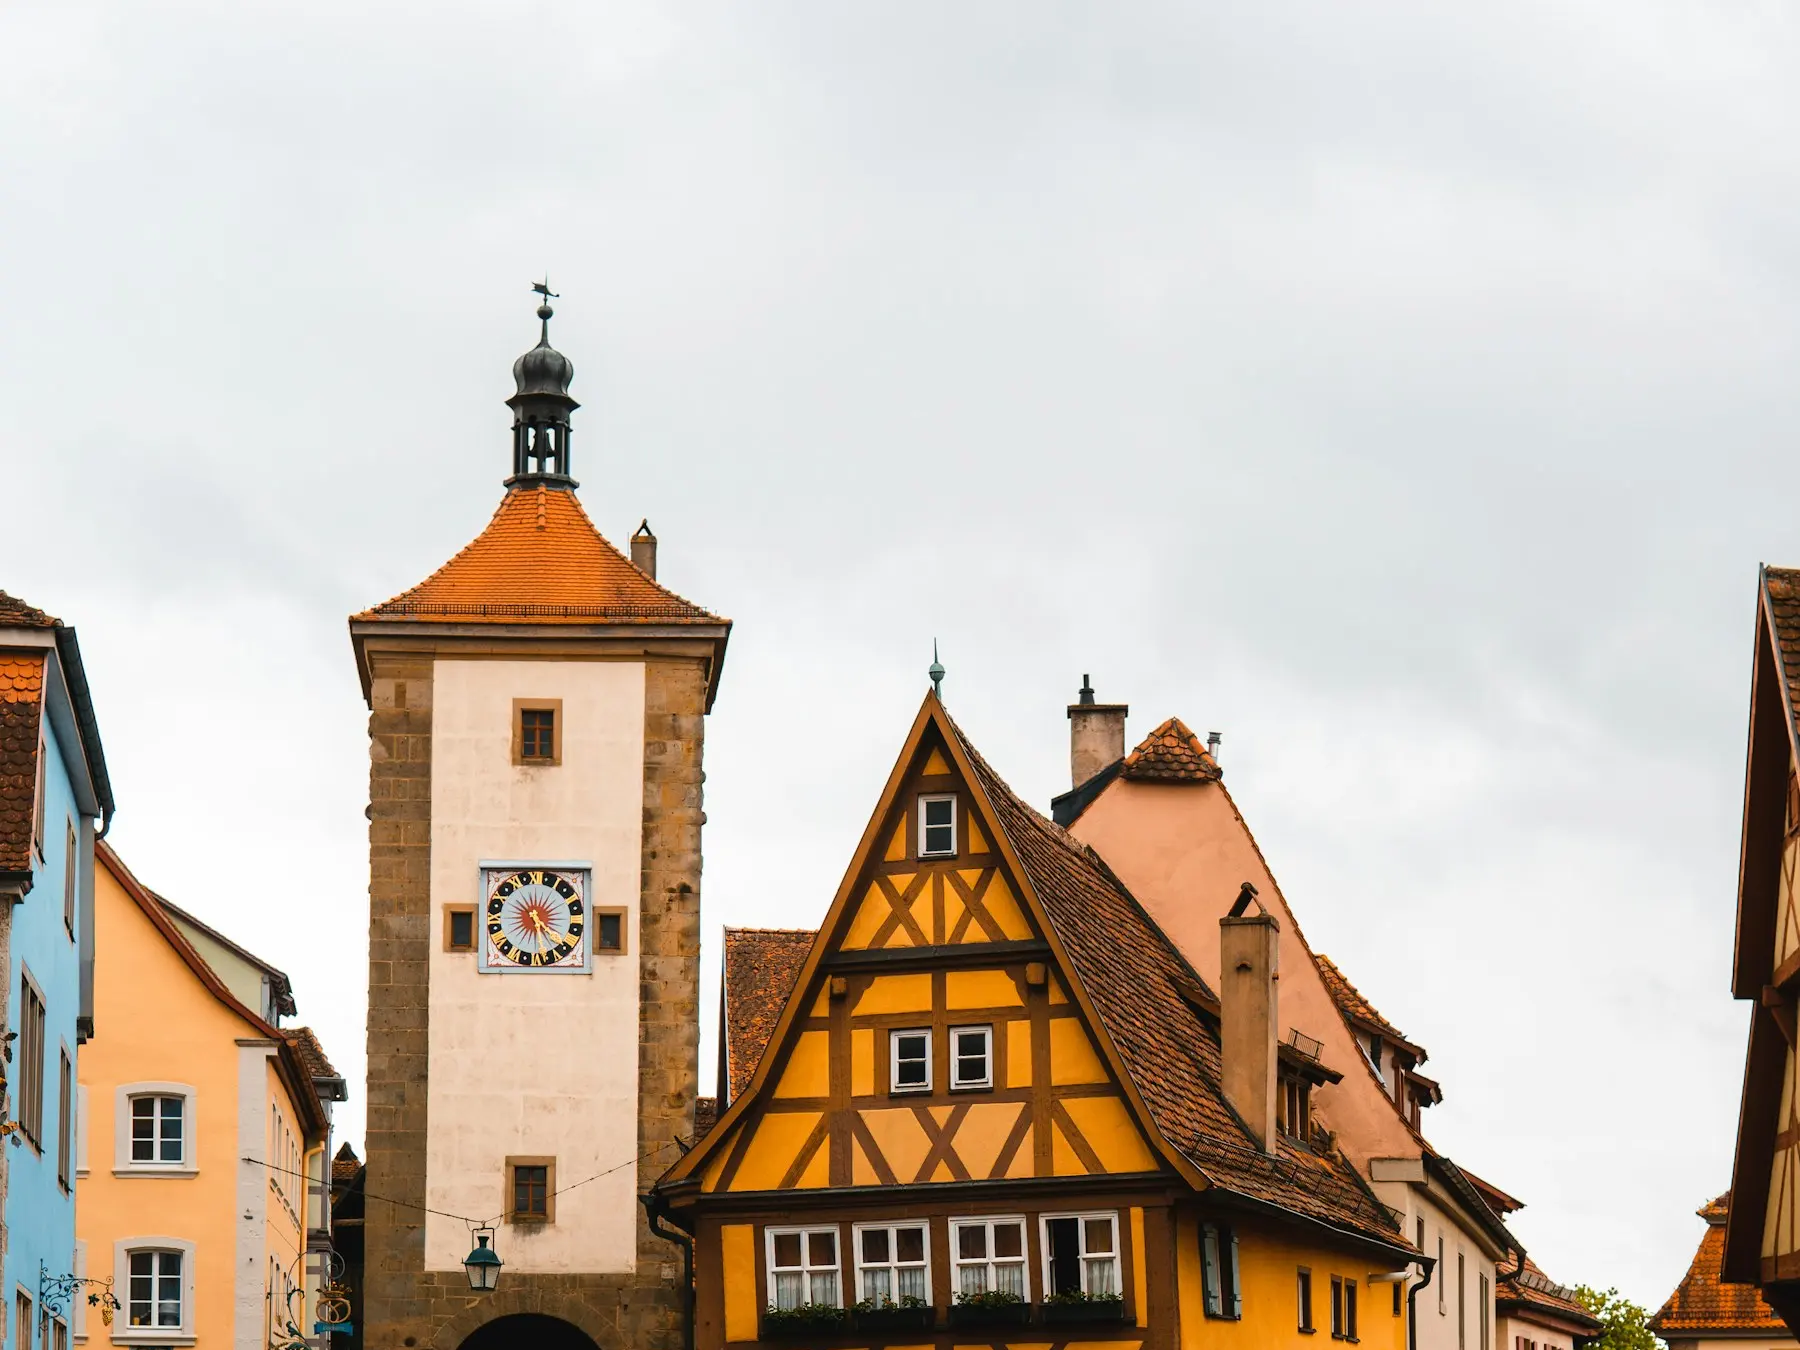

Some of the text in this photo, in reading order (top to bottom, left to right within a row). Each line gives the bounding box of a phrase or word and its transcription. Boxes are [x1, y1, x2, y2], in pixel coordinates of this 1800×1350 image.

[507, 875, 523, 890] XI
[528, 872, 543, 884] XII
[552, 877, 561, 889] I
[493, 891, 508, 903] X
[565, 893, 579, 904] II
[488, 912, 501, 925] IX
[570, 914, 583, 925] III
[507, 947, 520, 962] VII
[531, 952, 542, 966] VI
[553, 949, 563, 961] V
